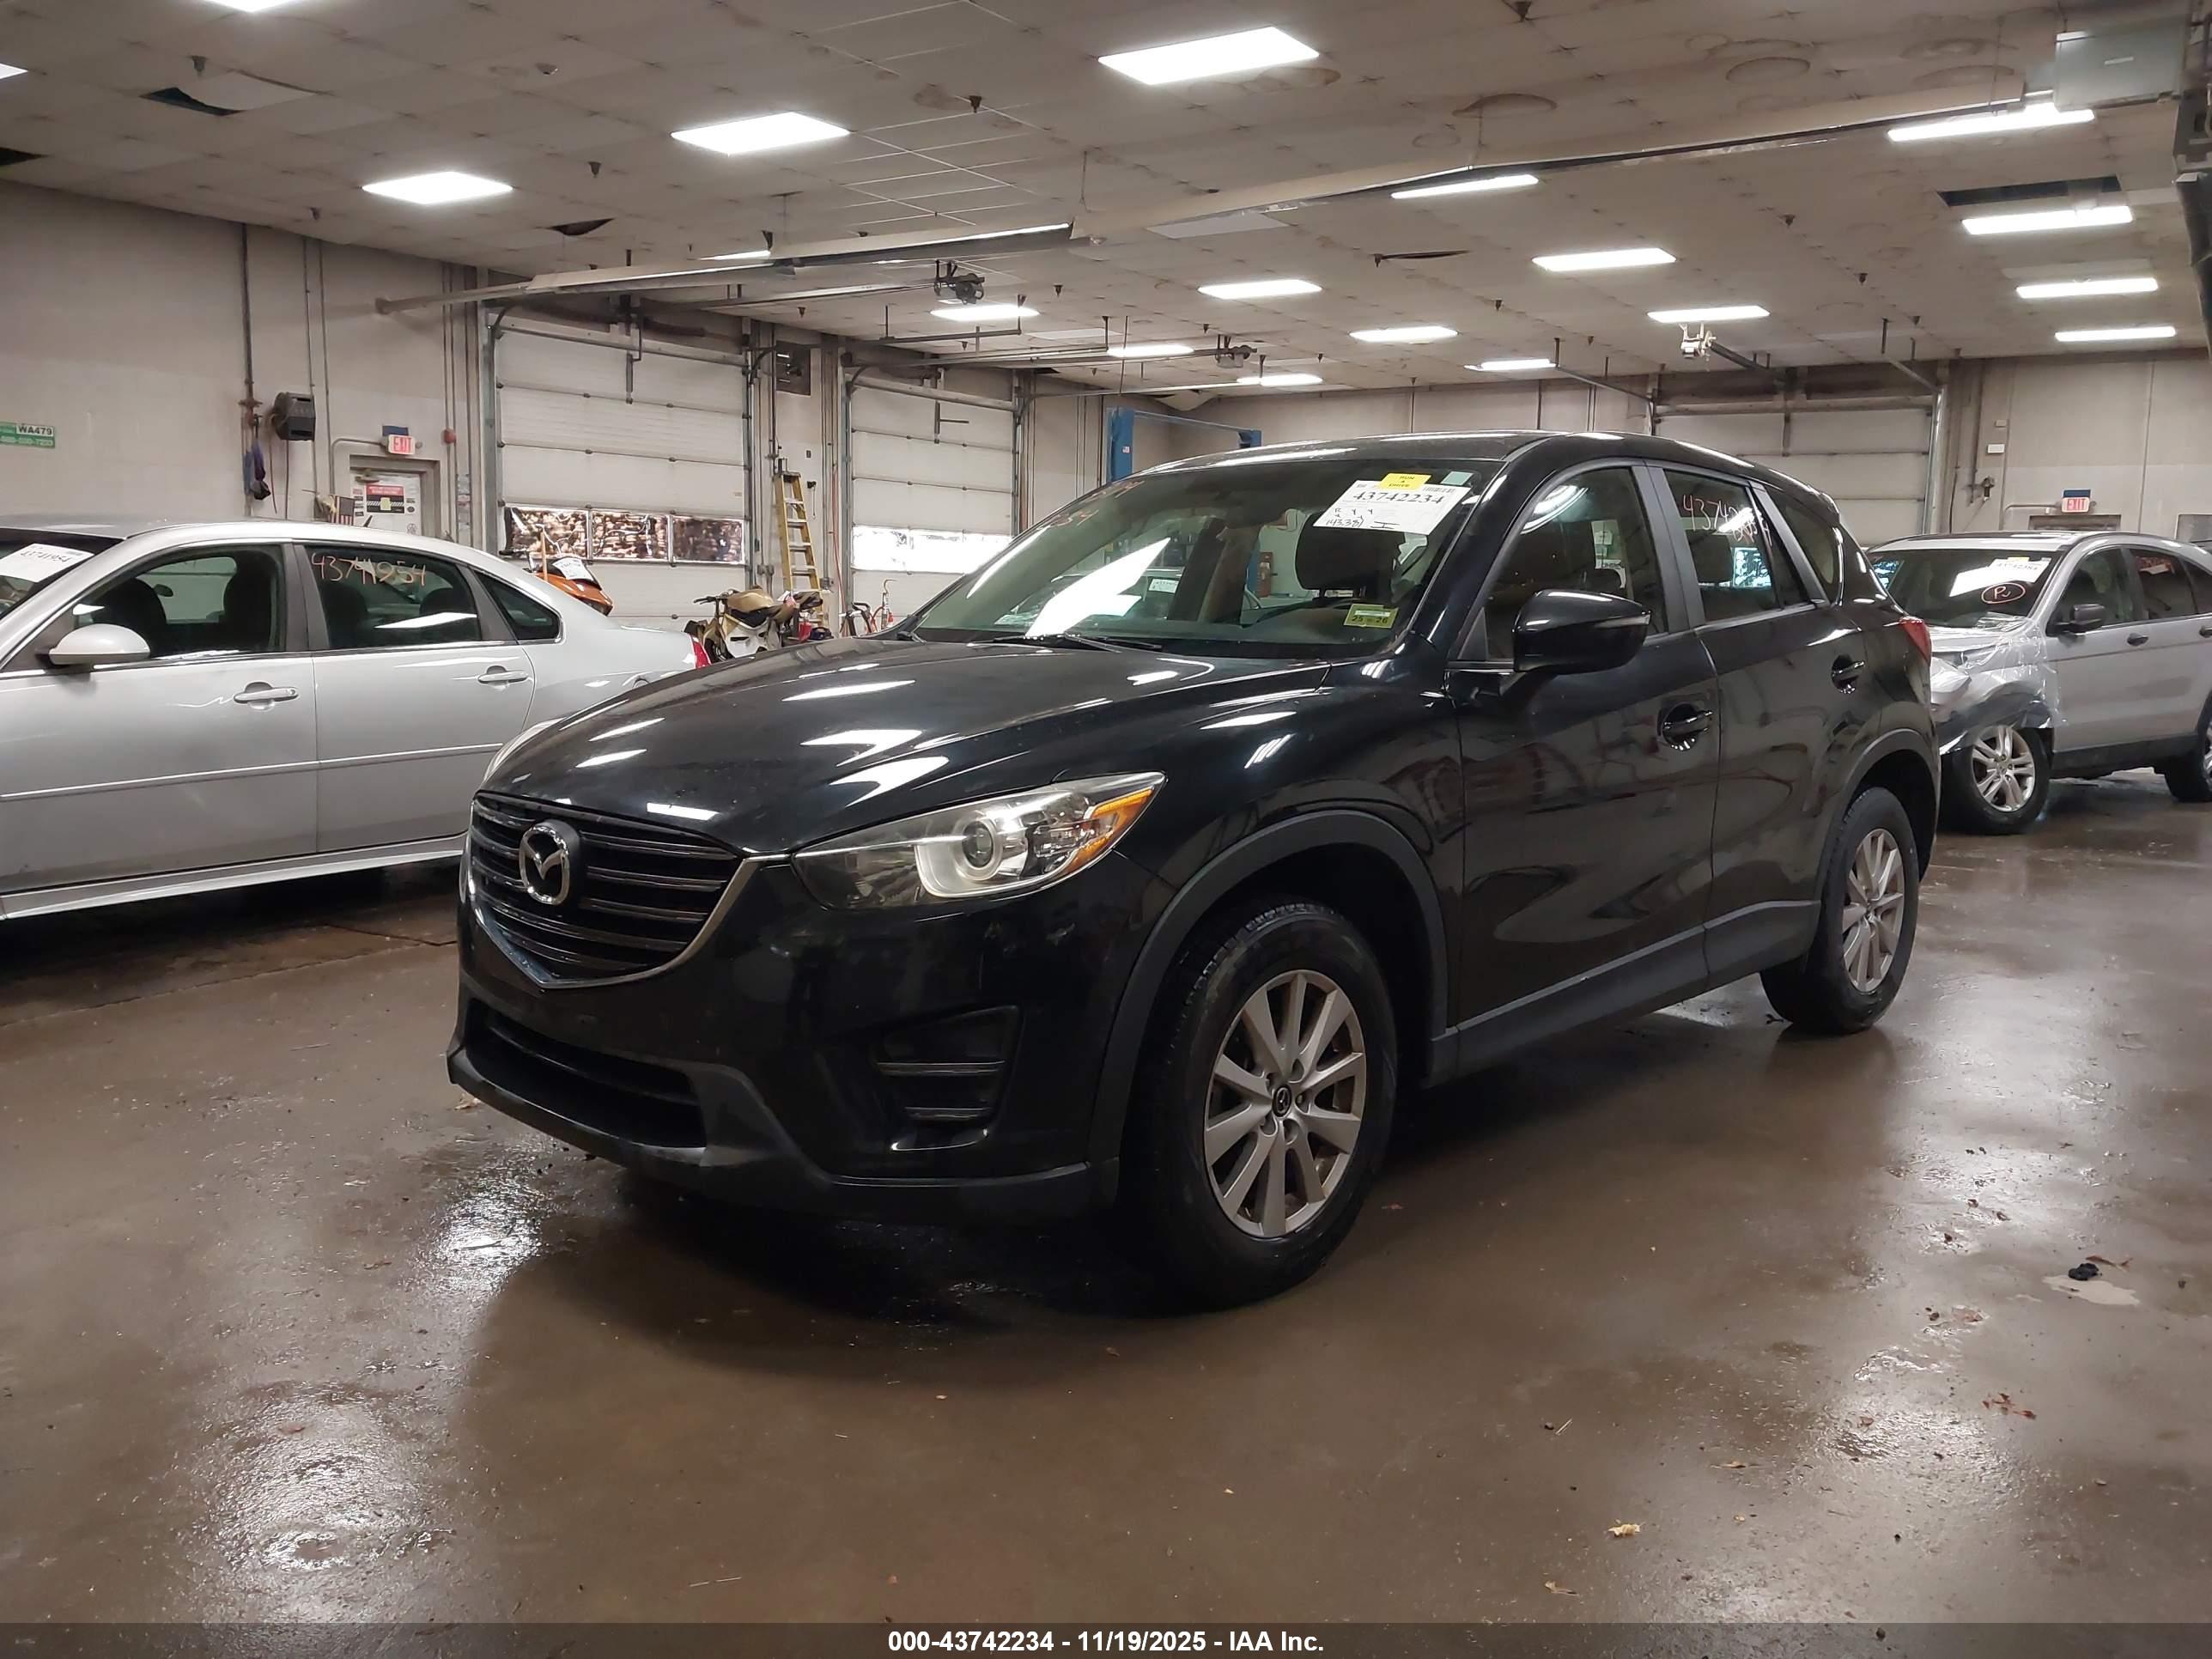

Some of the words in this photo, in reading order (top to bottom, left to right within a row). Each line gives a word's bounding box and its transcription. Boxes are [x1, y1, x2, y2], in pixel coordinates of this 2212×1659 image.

[18, 425, 53, 435] WA479
[393, 436, 411, 453] EXIT
[1352, 491, 1446, 505] 43742234
[2068, 498, 2086, 510] EXIT
